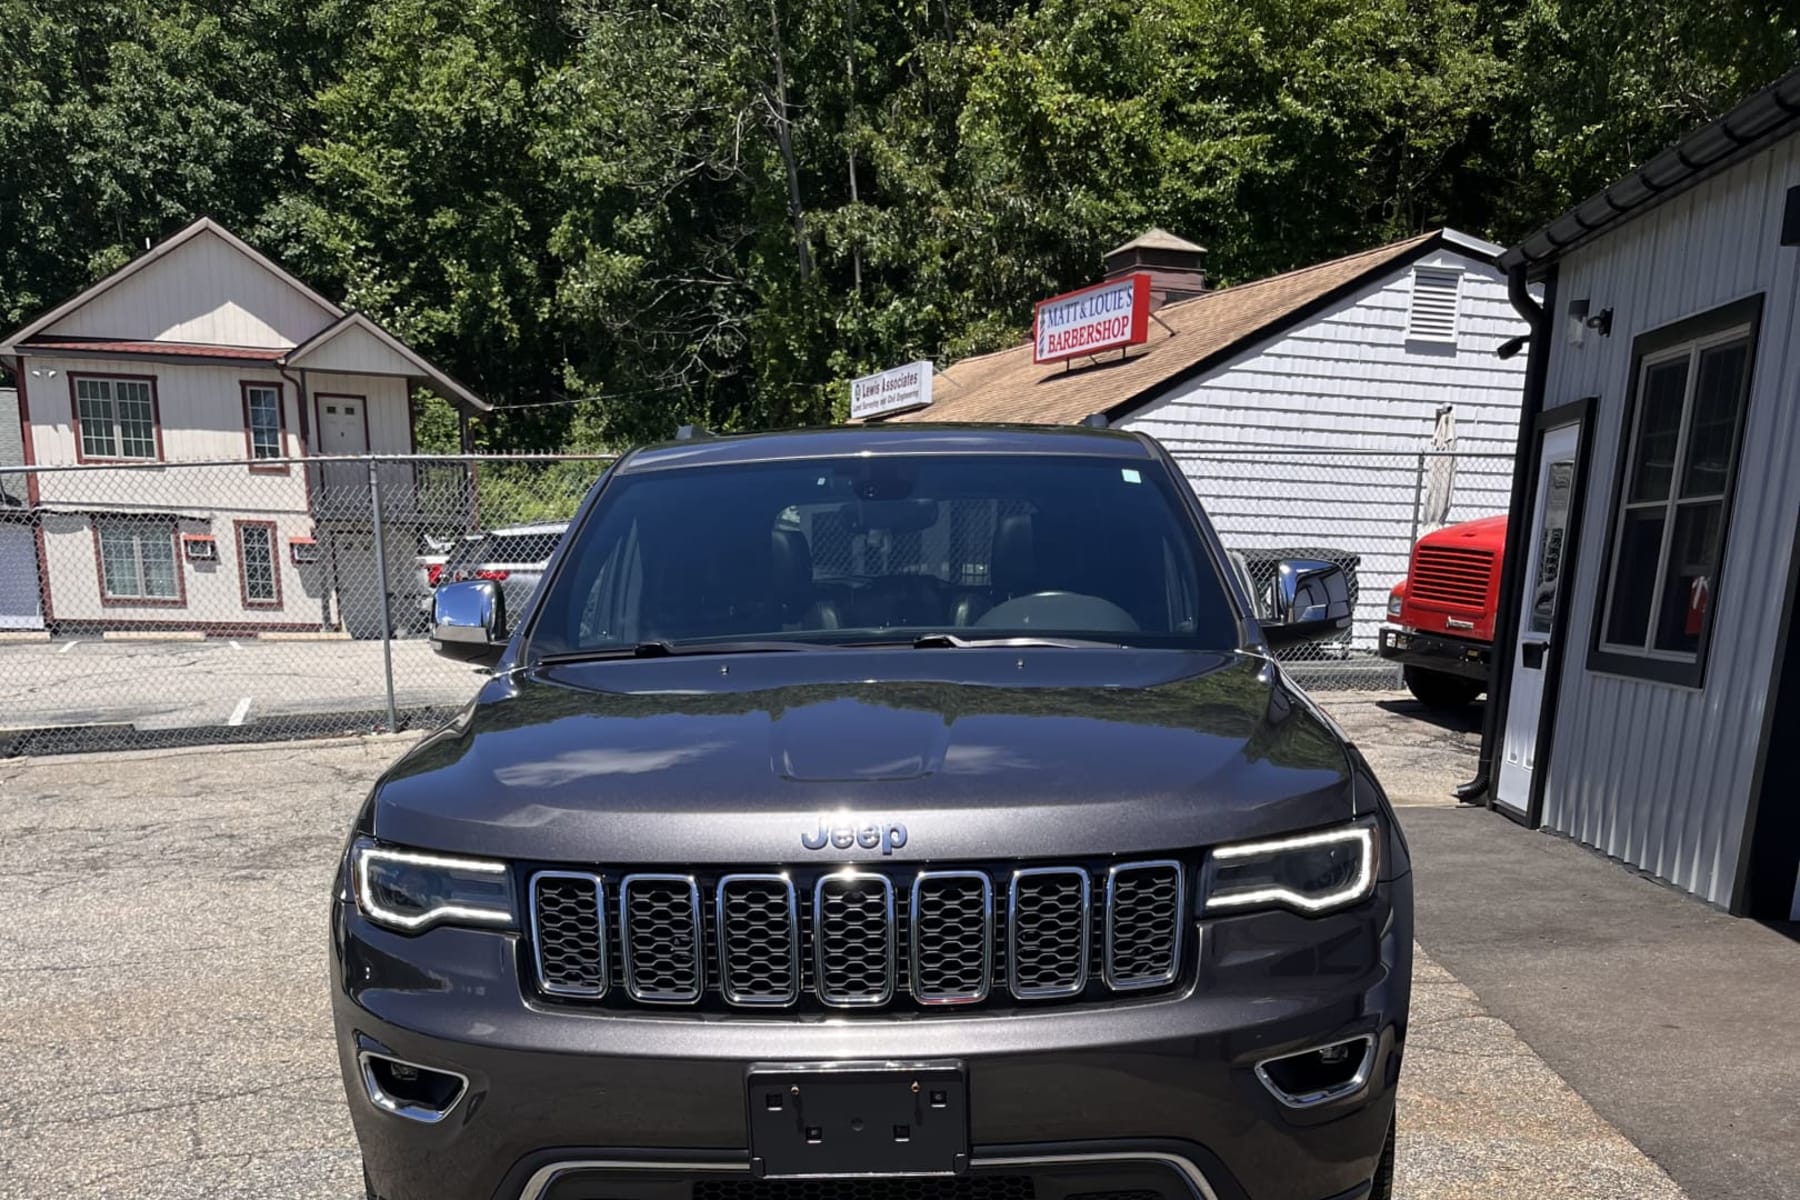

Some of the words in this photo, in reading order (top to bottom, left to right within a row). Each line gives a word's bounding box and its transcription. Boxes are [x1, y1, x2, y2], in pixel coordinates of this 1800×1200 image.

[1048, 301, 1080, 328] MATT
[1089, 285, 1132, 317] LOUIE'S
[1048, 315, 1129, 353] BARBERSHOP
[862, 381, 880, 398] Lewis
[882, 372, 918, 392] Associates
[801, 817, 908, 856] Jeep
